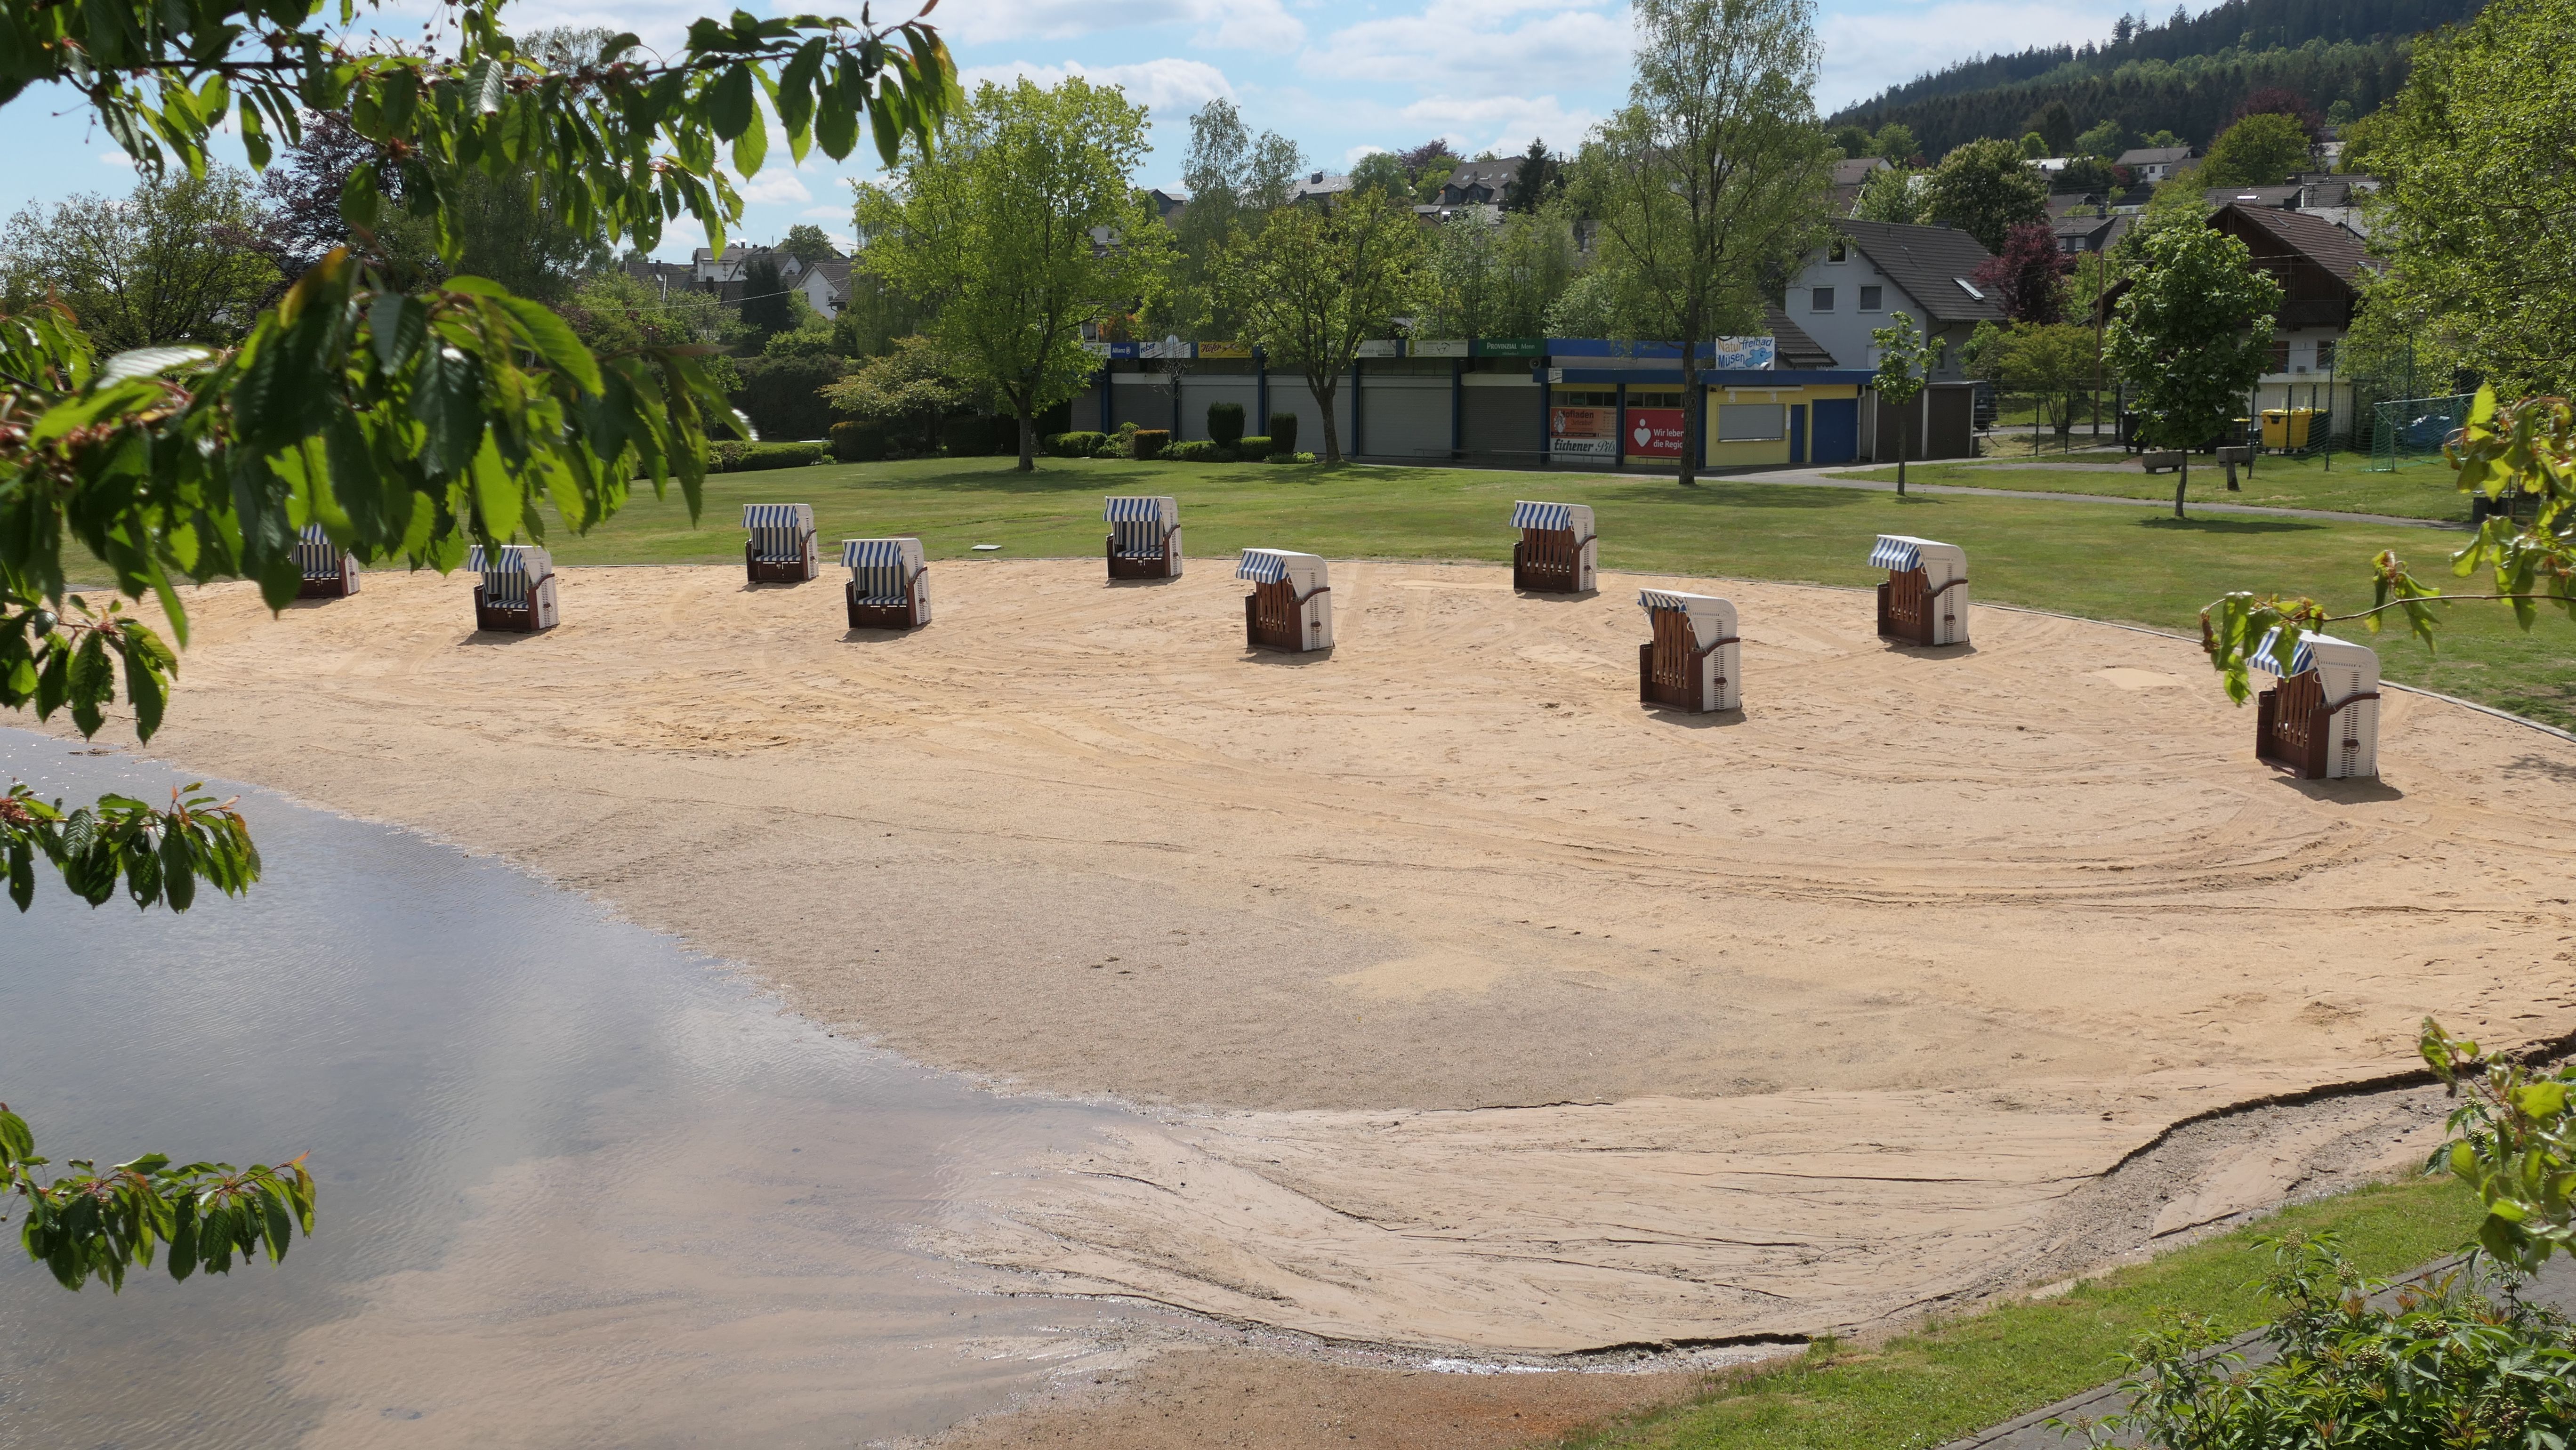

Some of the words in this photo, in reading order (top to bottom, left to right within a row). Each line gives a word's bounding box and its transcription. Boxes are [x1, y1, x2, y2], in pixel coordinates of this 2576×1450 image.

[1718, 353, 1745, 368] Müsen
[1554, 438, 1594, 451] Eichener
[1595, 440, 1615, 452] Pils
[1665, 441, 1683, 450] Regio
